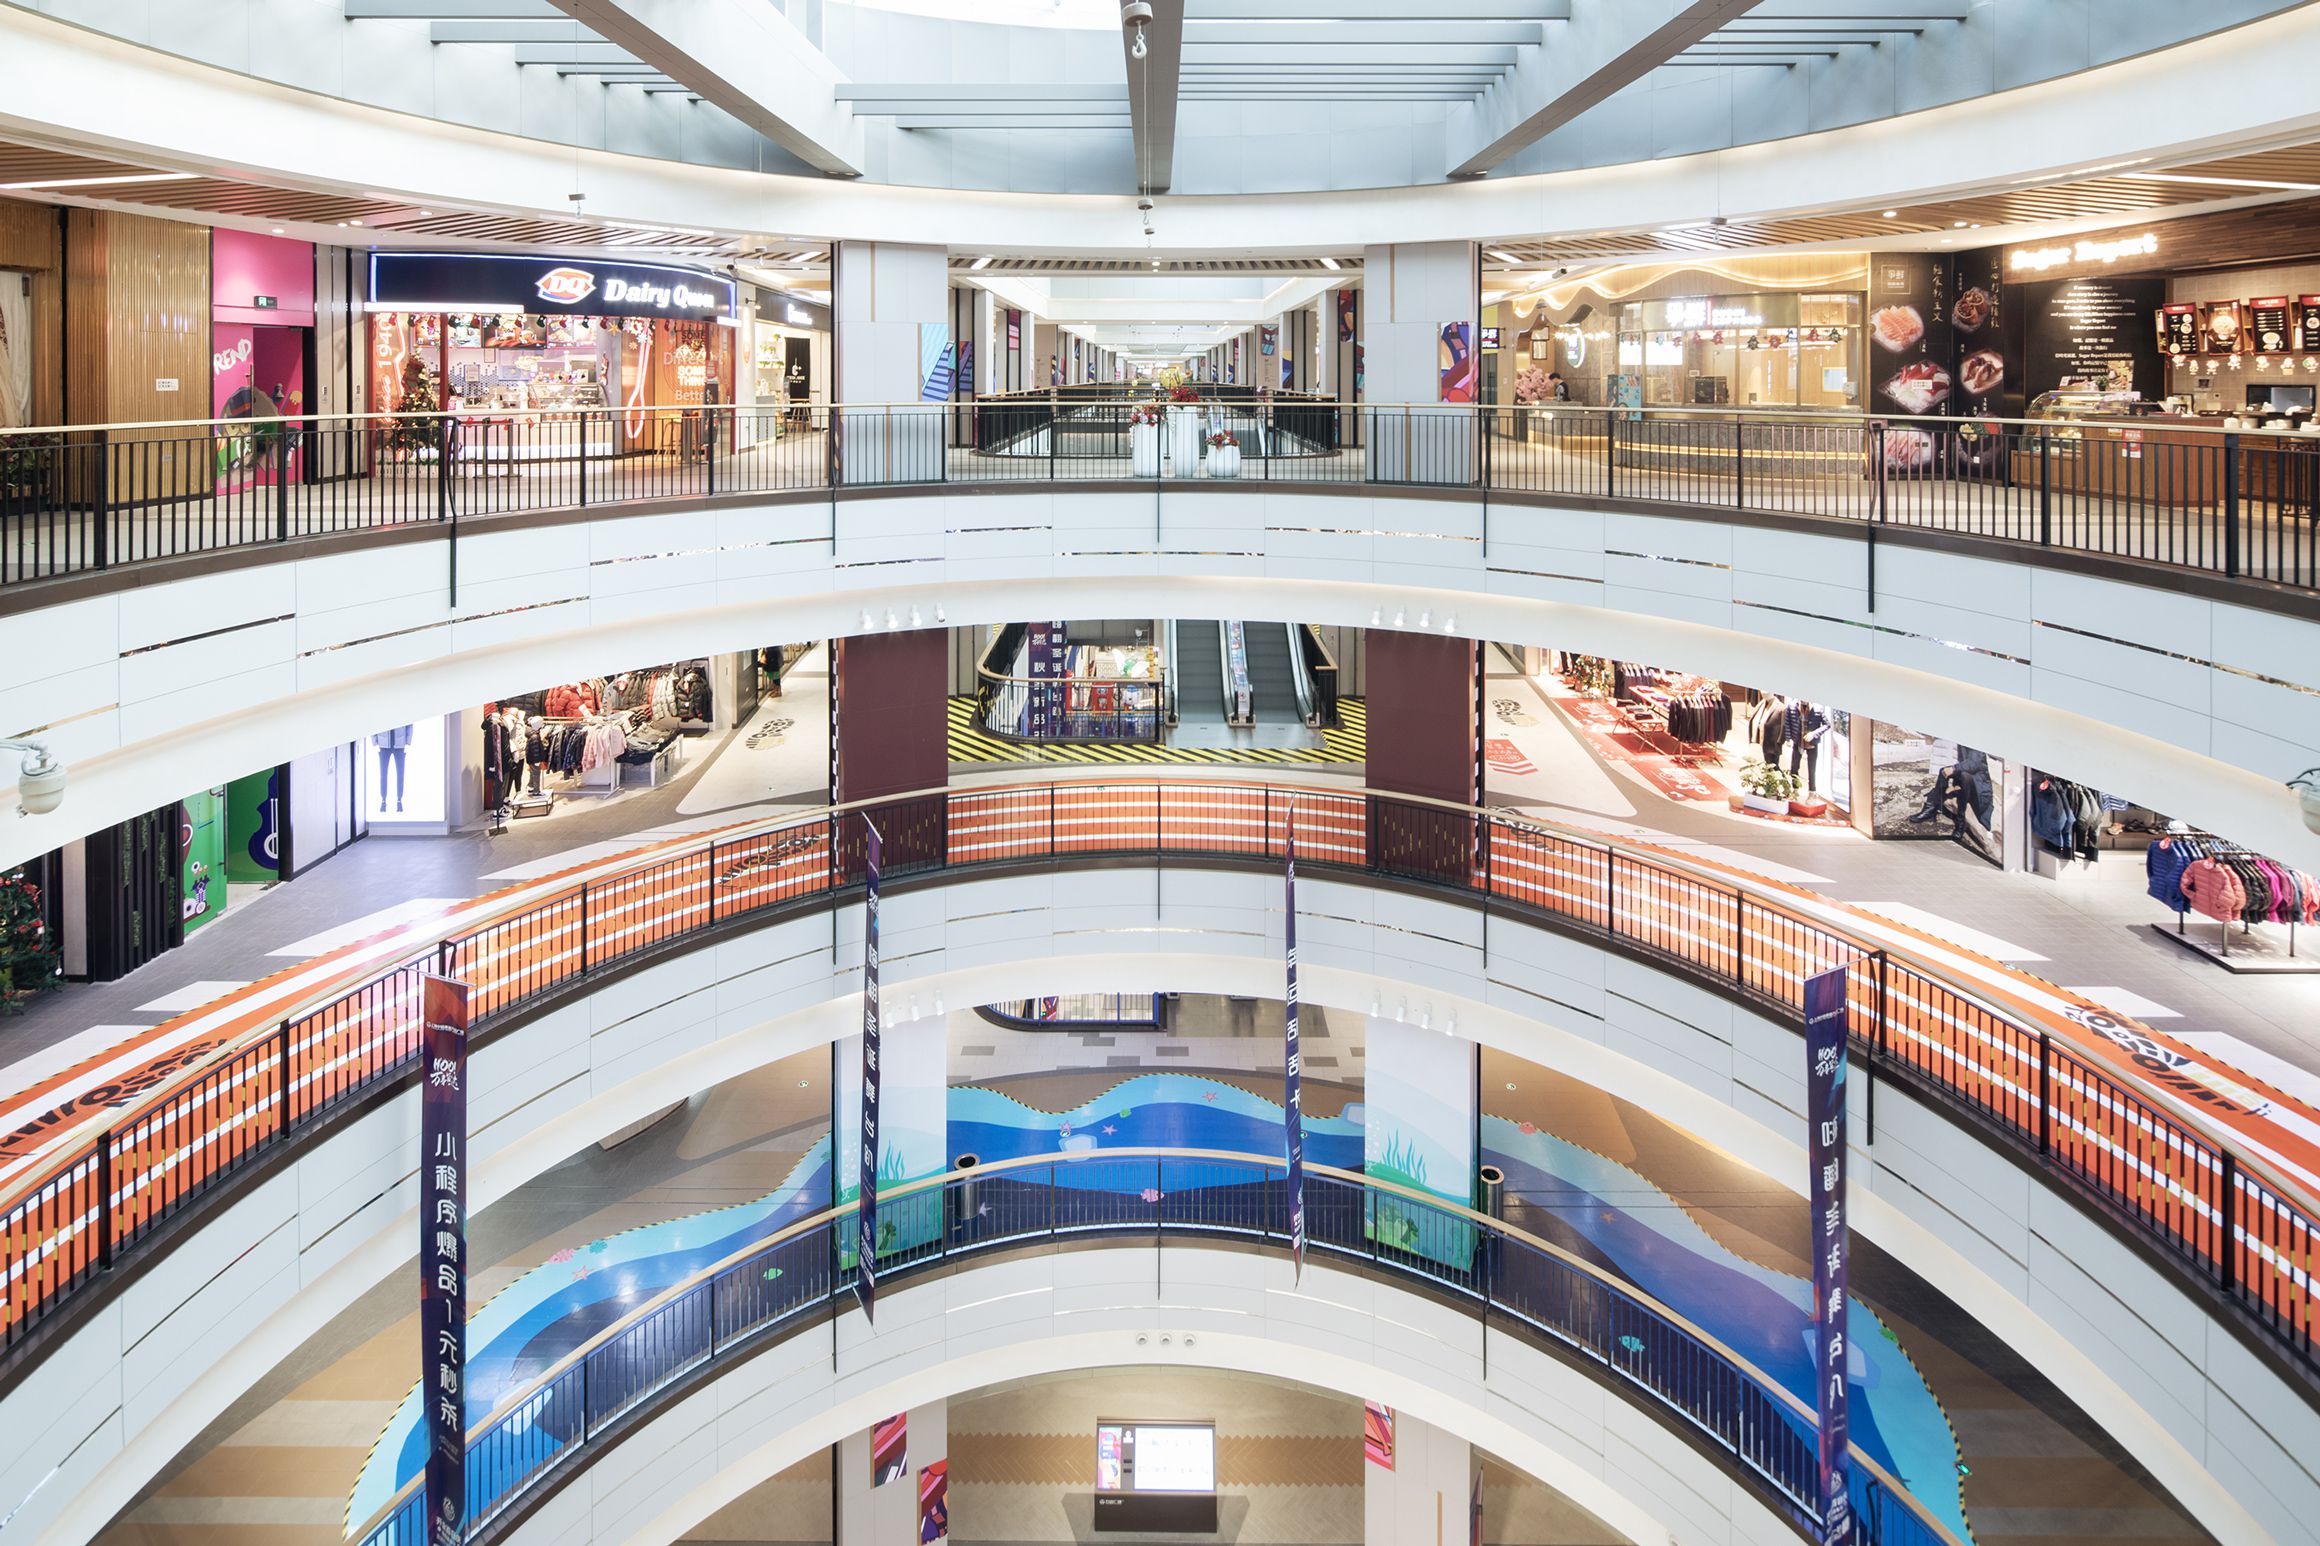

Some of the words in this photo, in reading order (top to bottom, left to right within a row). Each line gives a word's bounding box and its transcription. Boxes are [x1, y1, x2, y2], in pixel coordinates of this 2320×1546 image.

[550, 275, 584, 293] DQ
[604, 279, 670, 308] Dairy
[377, 316, 393, 368] 1940
[675, 389, 704, 401] Bette
